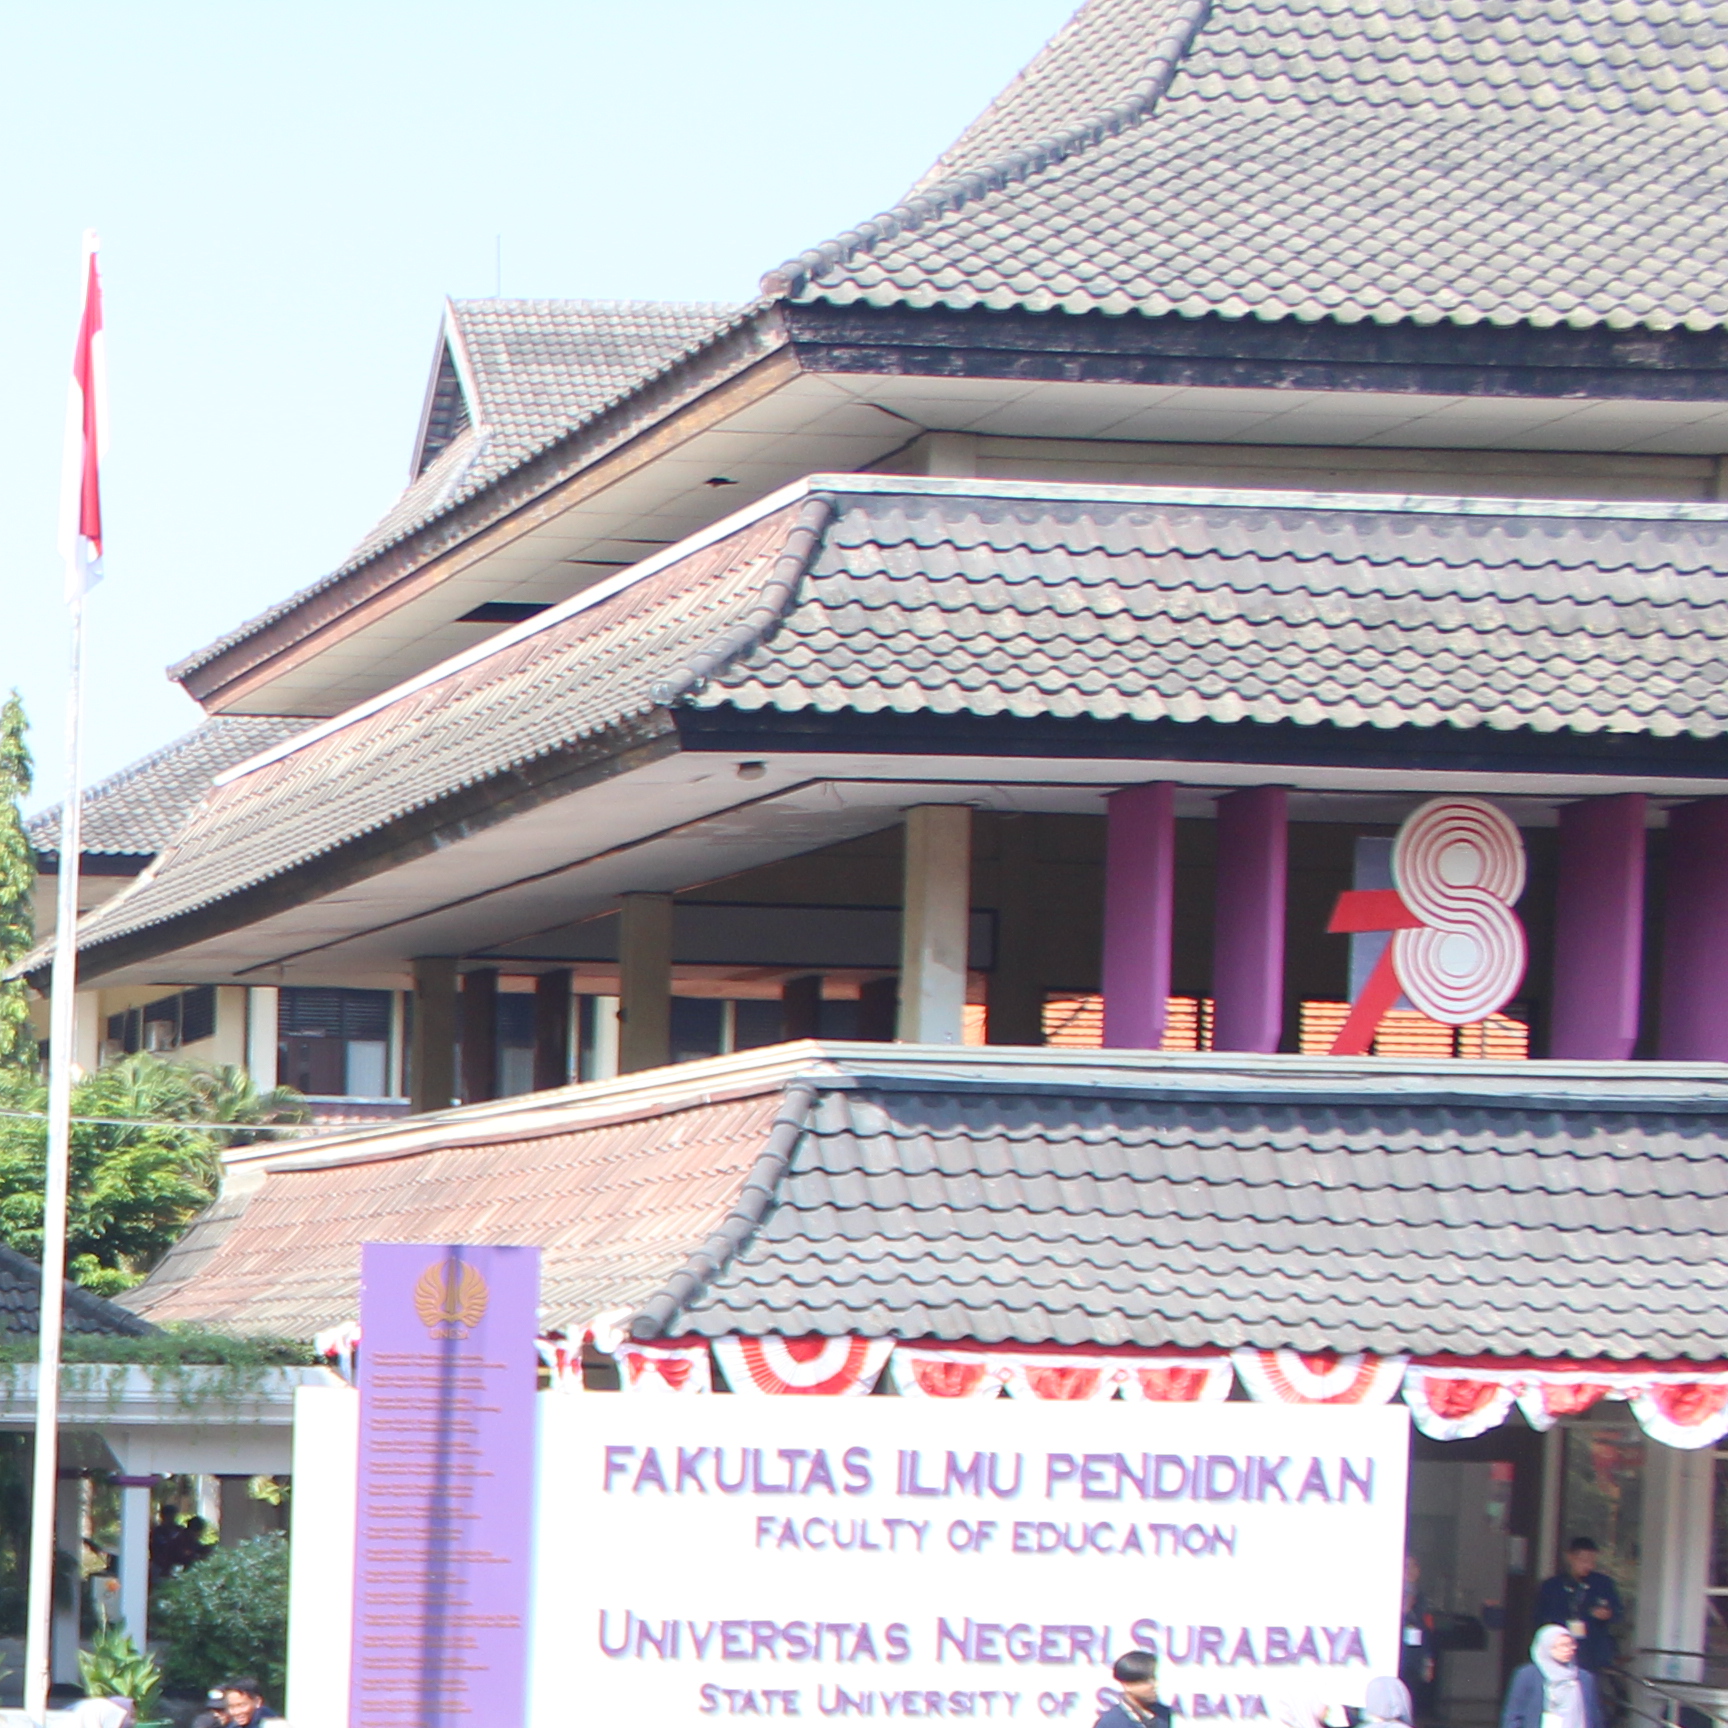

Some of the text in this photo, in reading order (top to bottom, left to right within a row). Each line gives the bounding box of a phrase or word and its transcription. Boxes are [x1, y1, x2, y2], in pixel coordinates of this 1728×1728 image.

[602, 1445, 1375, 1503] FAKULTAS ILMU PENDIDIKAN
[755, 1516, 1237, 1556] FACULTY OF EDUCATION
[599, 1609, 1371, 1667] UNIVERSITAS NEGERI SURABAYA
[699, 1683, 1271, 1719] STATE UNIVERSITY OF SABAYA
